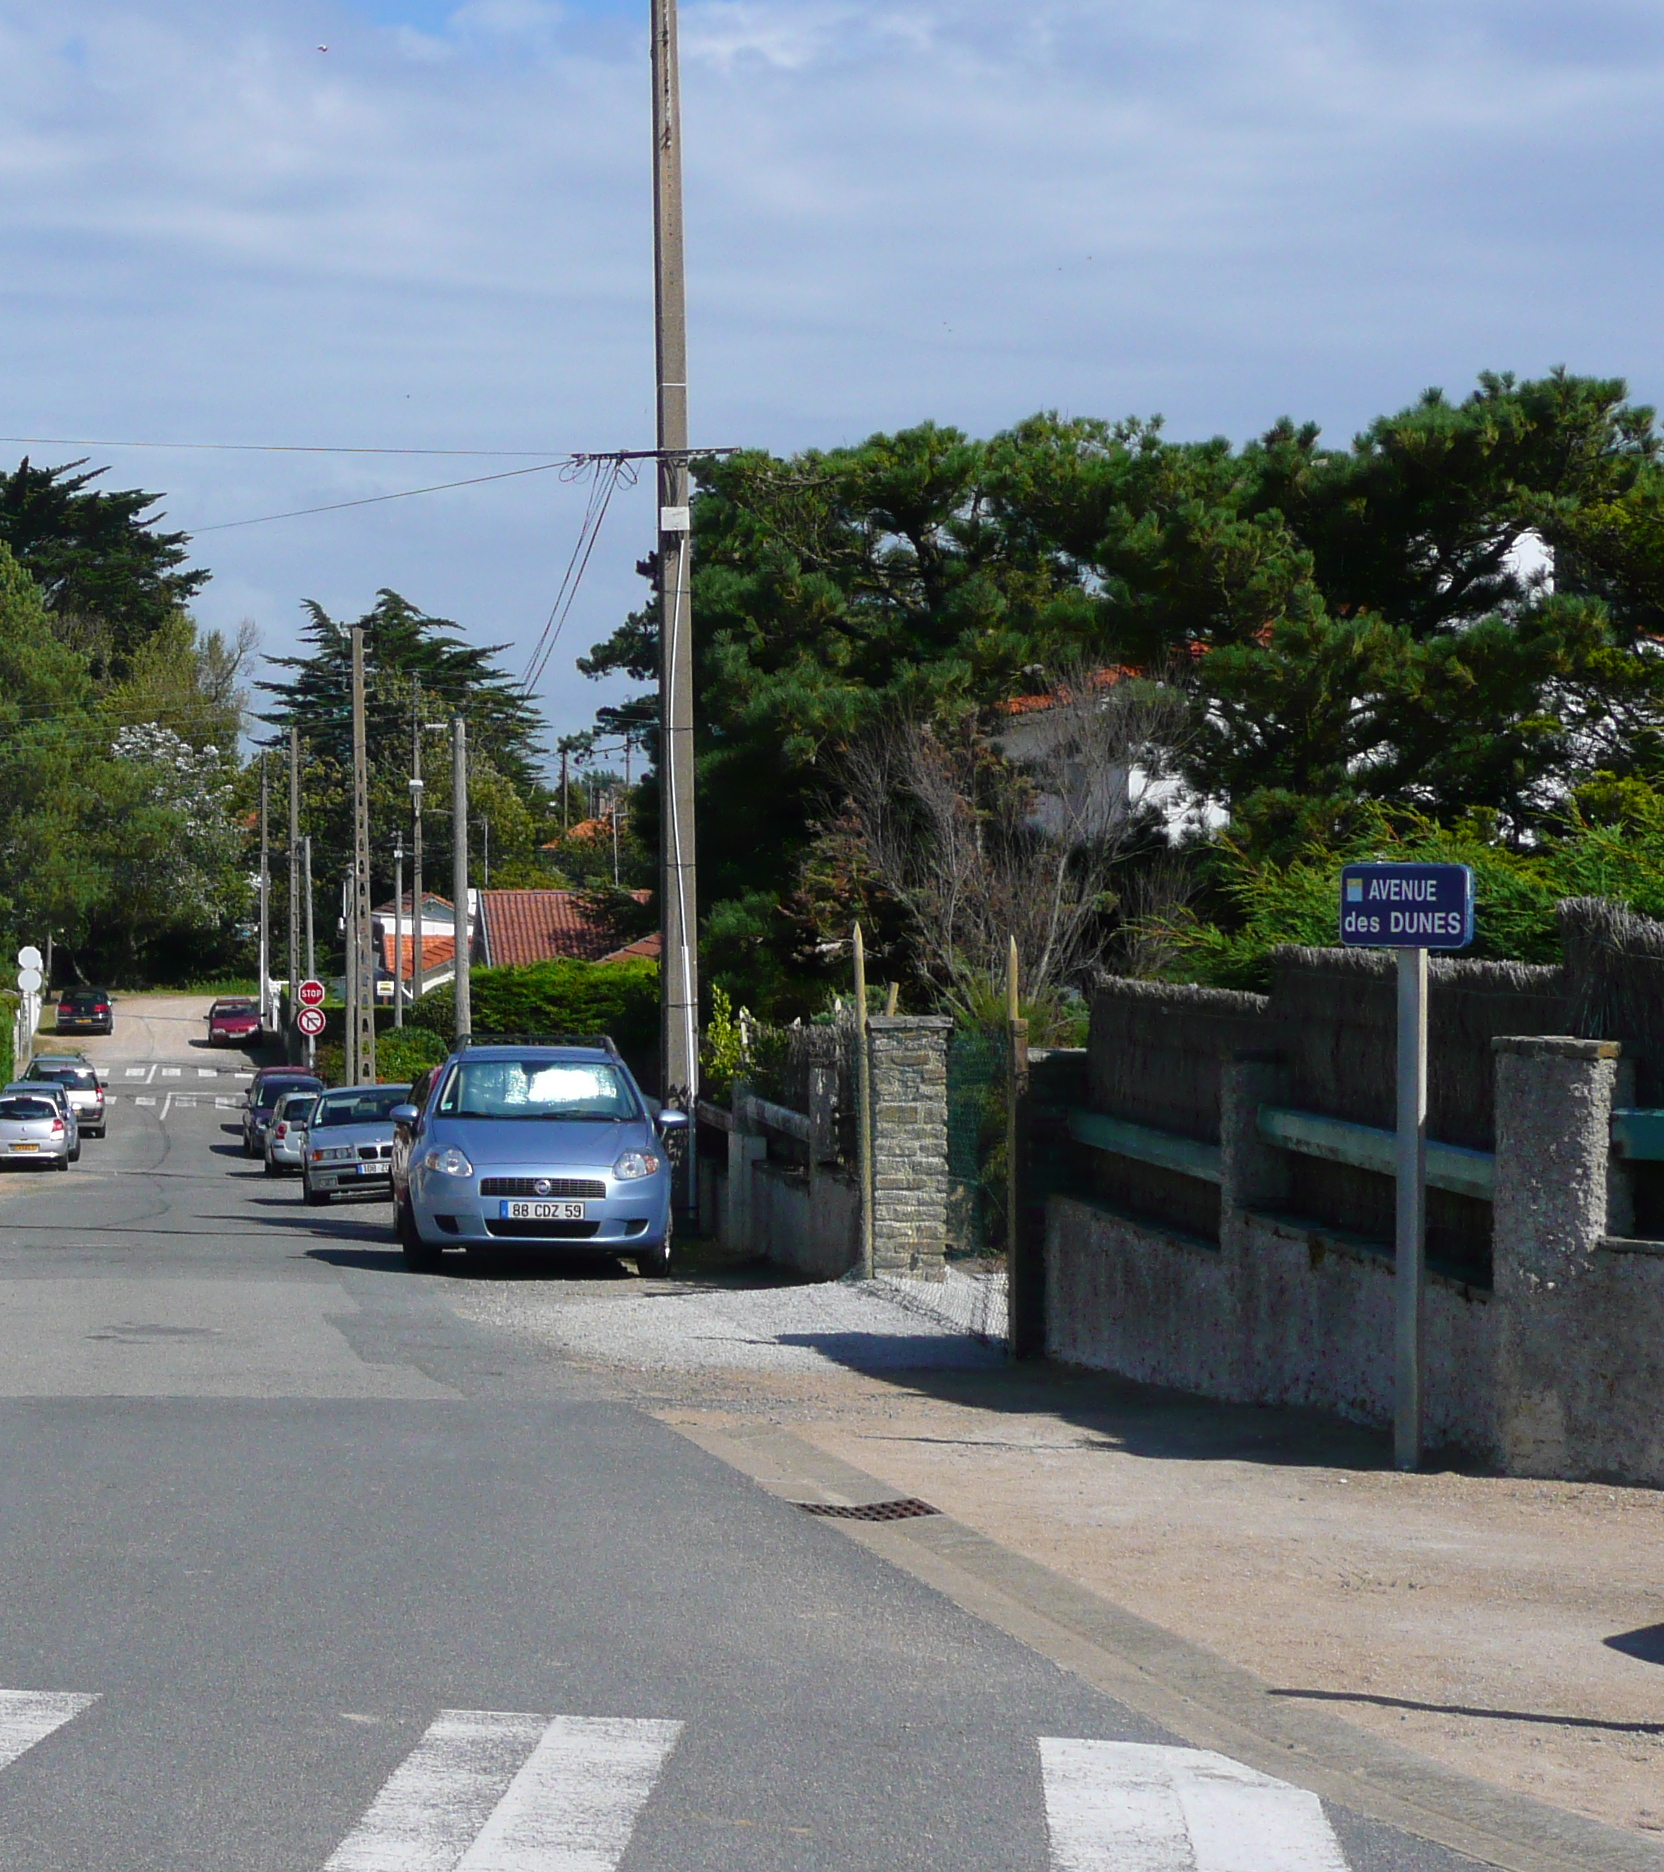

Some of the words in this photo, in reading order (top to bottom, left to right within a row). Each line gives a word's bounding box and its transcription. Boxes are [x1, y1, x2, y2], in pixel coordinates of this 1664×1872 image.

[1368, 879, 1438, 902] AVENUE
[1344, 911, 1380, 933] des
[1390, 911, 1461, 934] DUNES
[301, 989, 322, 998] STOP
[512, 1203, 529, 1217] 88
[534, 1204, 559, 1218] CDZ
[564, 1204, 581, 1218] 59
